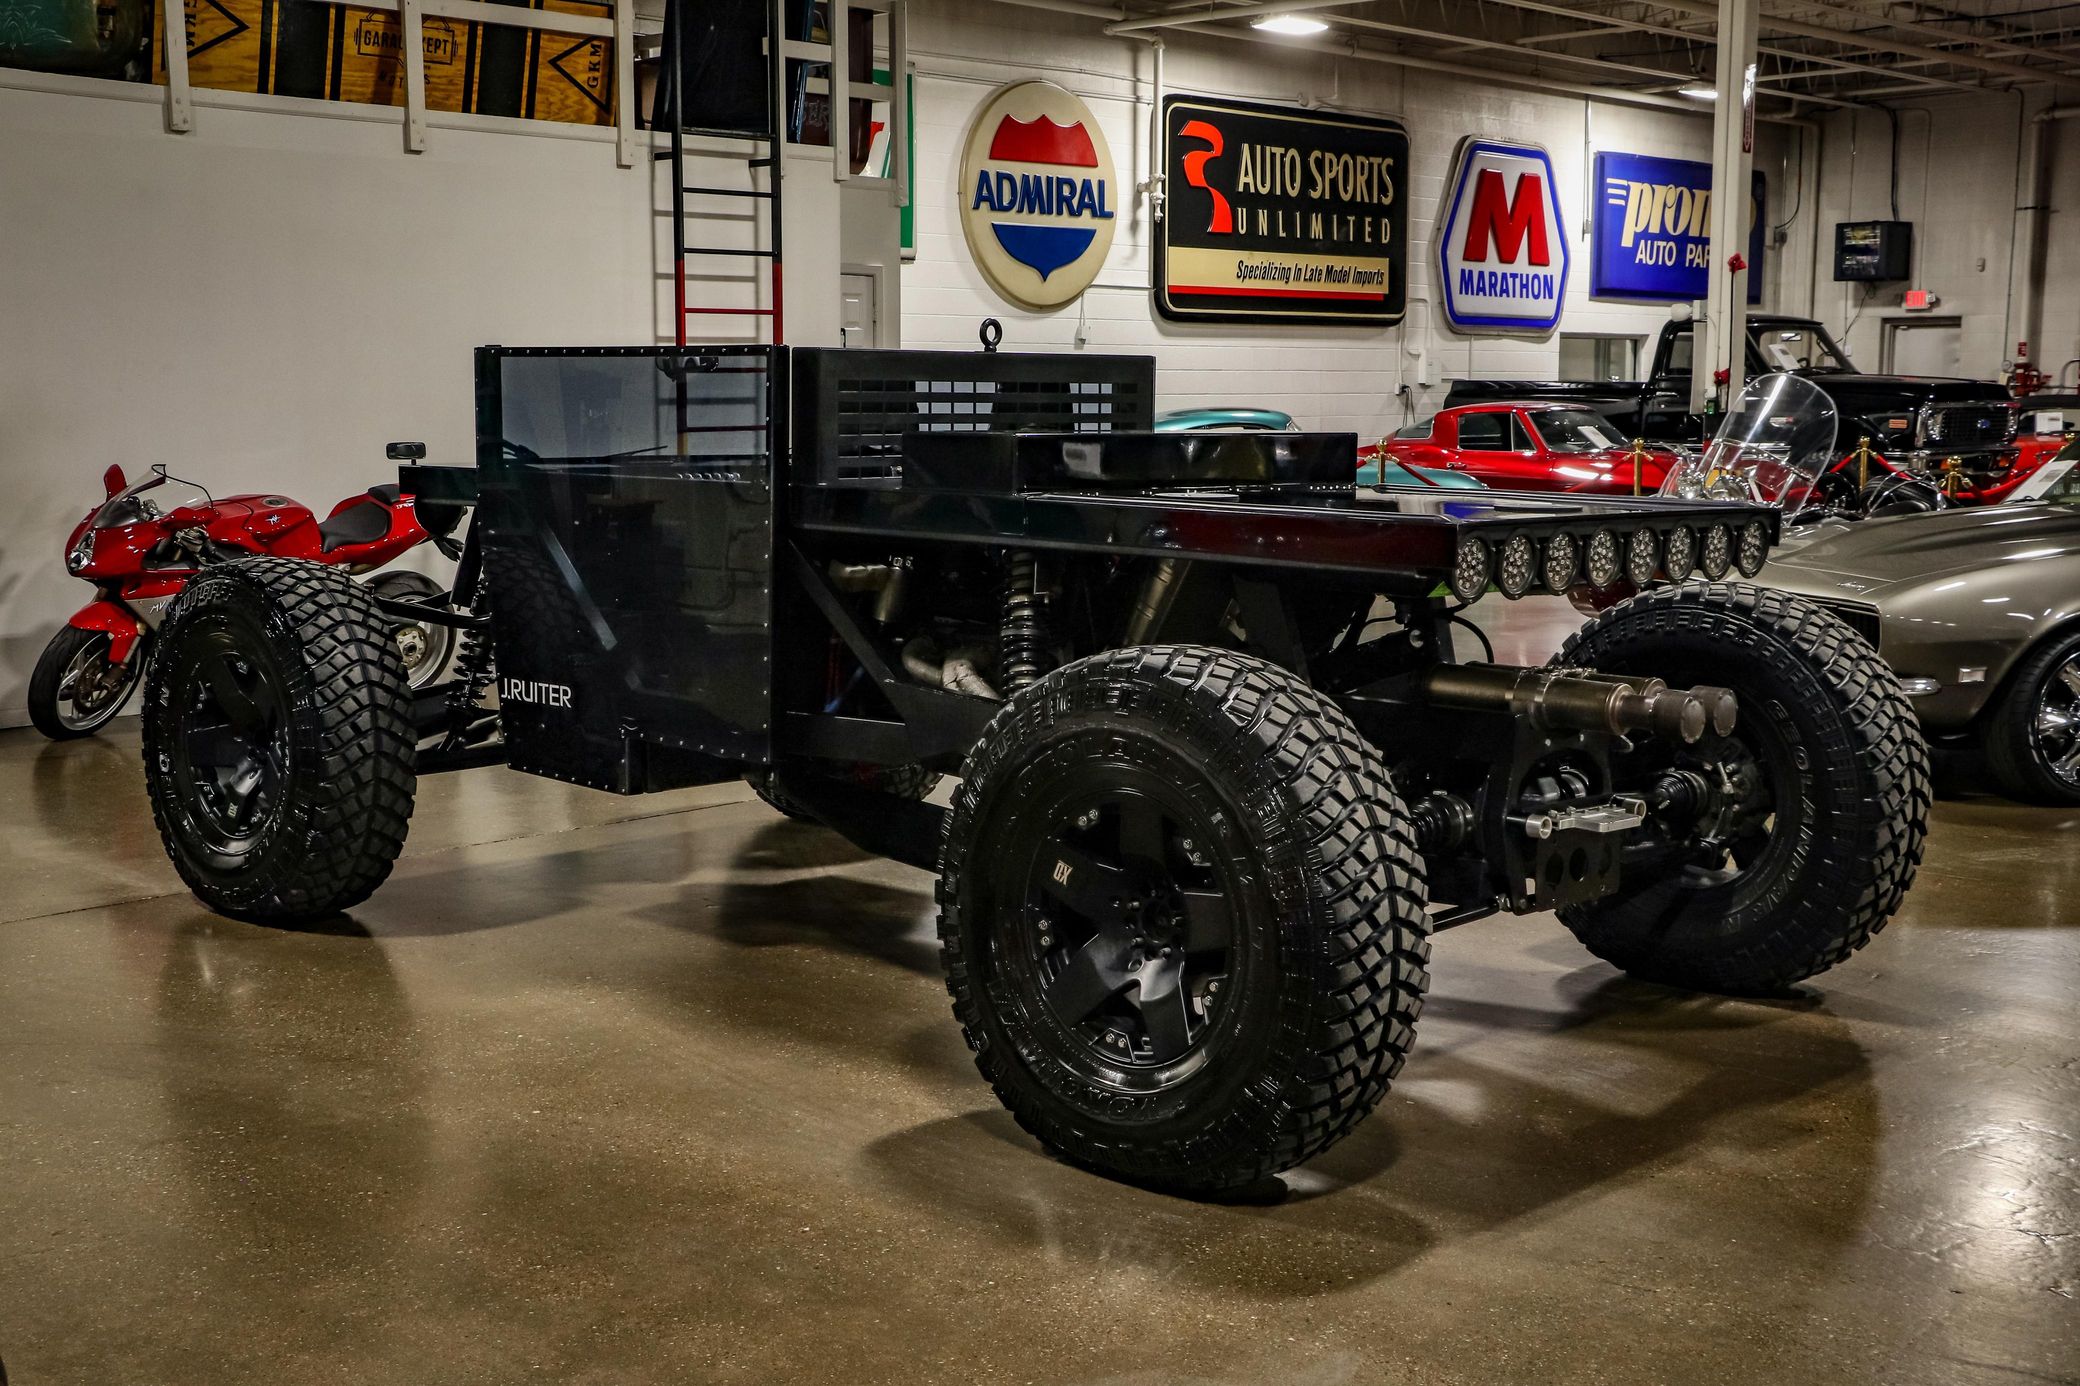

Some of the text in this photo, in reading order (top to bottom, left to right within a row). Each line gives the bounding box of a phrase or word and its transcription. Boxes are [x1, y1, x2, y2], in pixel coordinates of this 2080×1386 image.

[363, 30, 403, 49] GARA
[587, 42, 602, 88] GKM
[1237, 143, 1394, 206] AUTO SPORTS
[972, 169, 1114, 218] ADMIRAL
[1237, 207, 1391, 244] UNLIMITED
[1635, 240, 1711, 268] AUTO PAR
[1236, 259, 1385, 288] Specializing In Late Model Imports
[1459, 268, 1554, 300] MARATHON
[501, 677, 572, 708] J.RUITER
